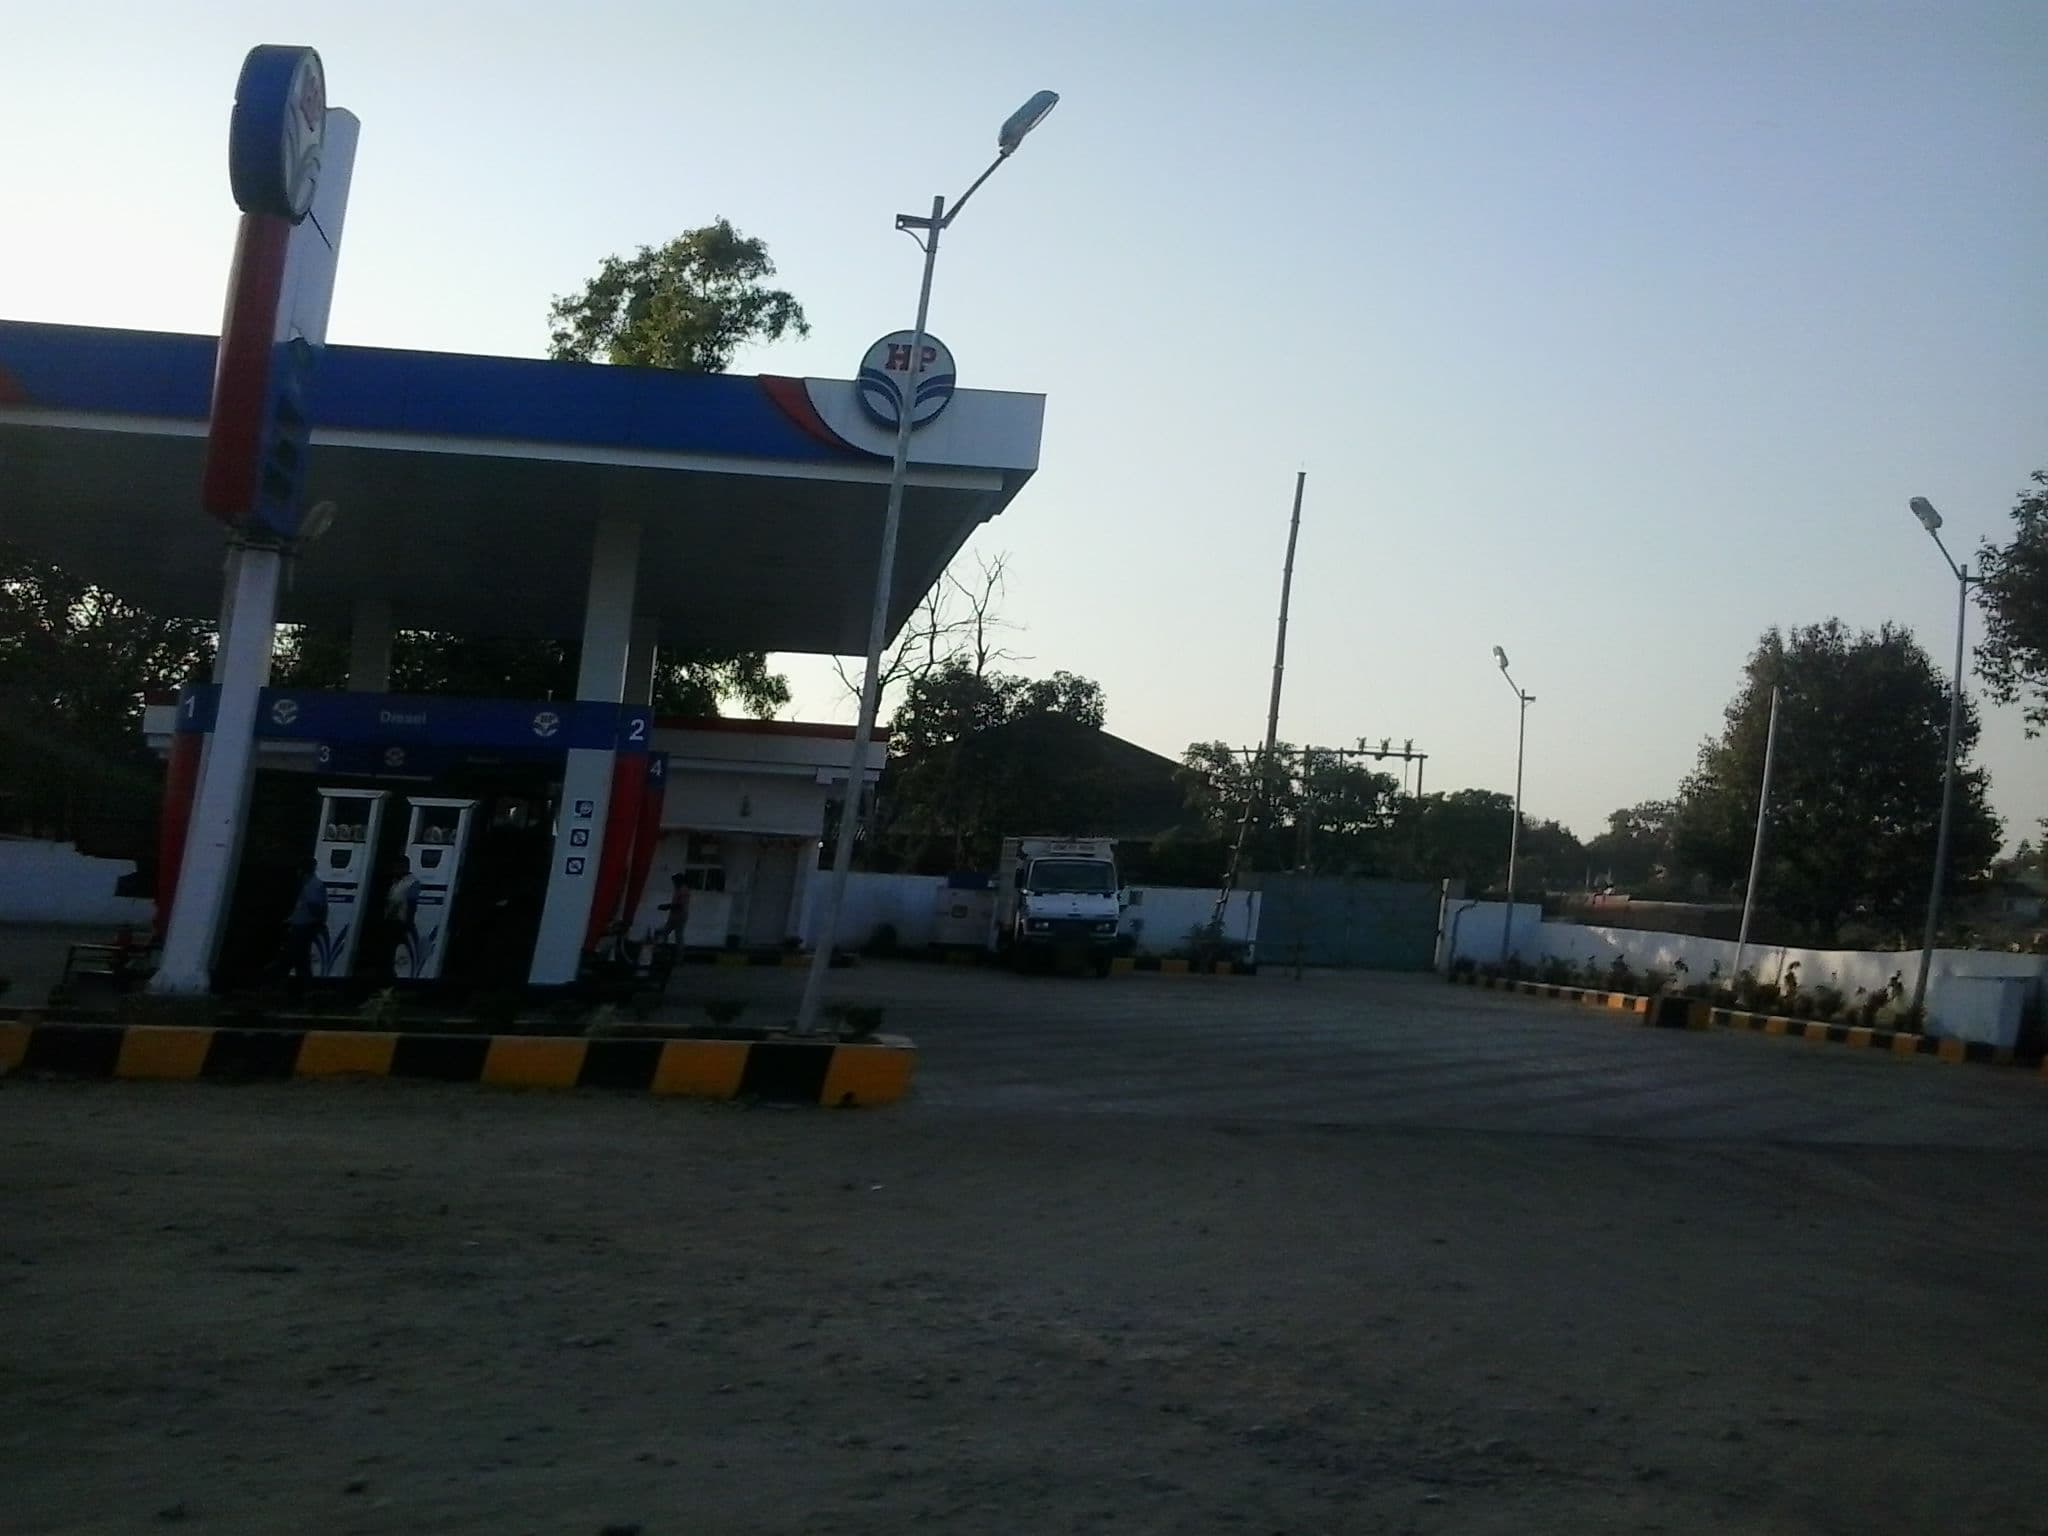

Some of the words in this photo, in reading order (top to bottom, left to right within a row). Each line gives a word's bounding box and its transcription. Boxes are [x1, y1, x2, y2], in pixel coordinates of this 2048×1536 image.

[185, 696, 195, 718] 1
[629, 719, 645, 741] 2
[319, 745, 331, 763] 3
[650, 759, 663, 776] 4
